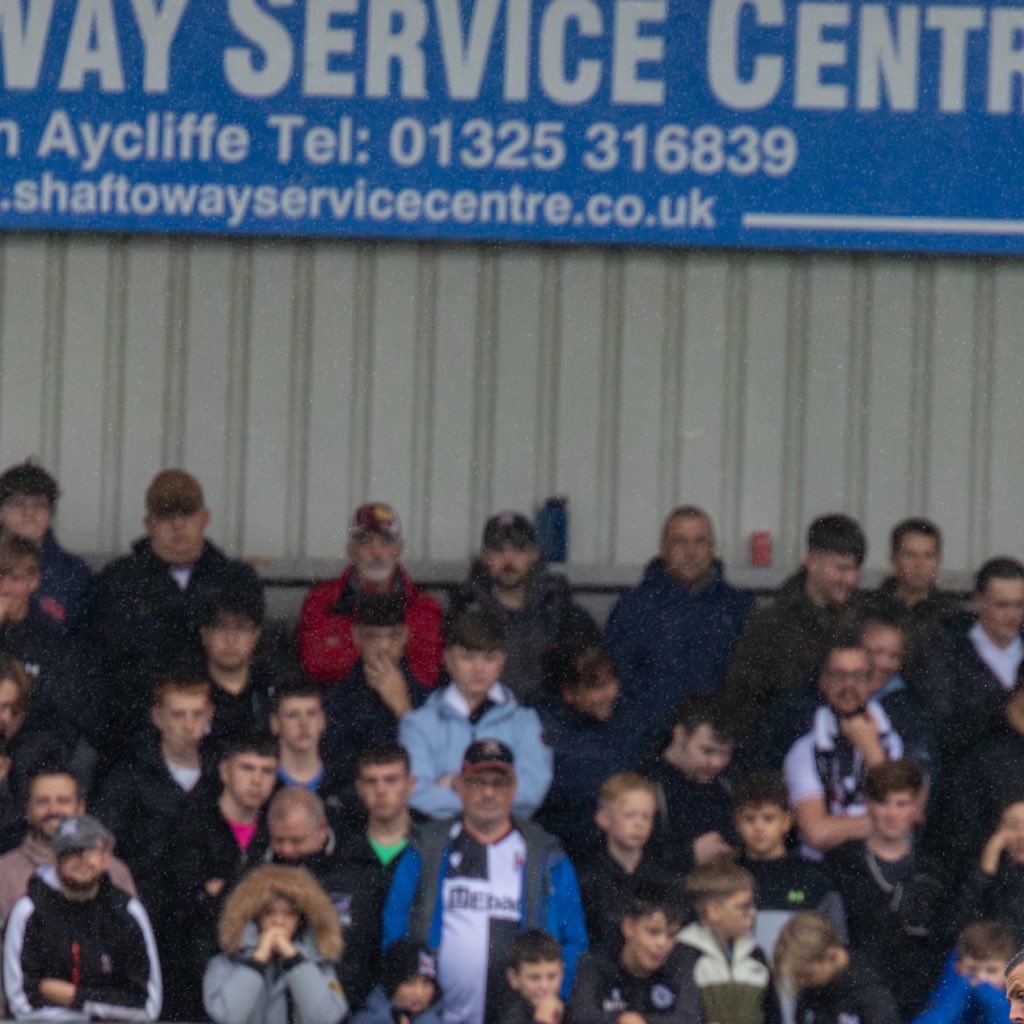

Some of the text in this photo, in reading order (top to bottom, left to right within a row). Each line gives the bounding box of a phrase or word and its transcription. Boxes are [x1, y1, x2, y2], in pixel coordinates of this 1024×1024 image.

[223, 0, 666, 105] SERVICE
[36, 108, 250, 171] Aycliffe
[266, 114, 370, 165] Tel:
[389, 116, 567, 171] 01325
[583, 121, 798, 177] 316839
